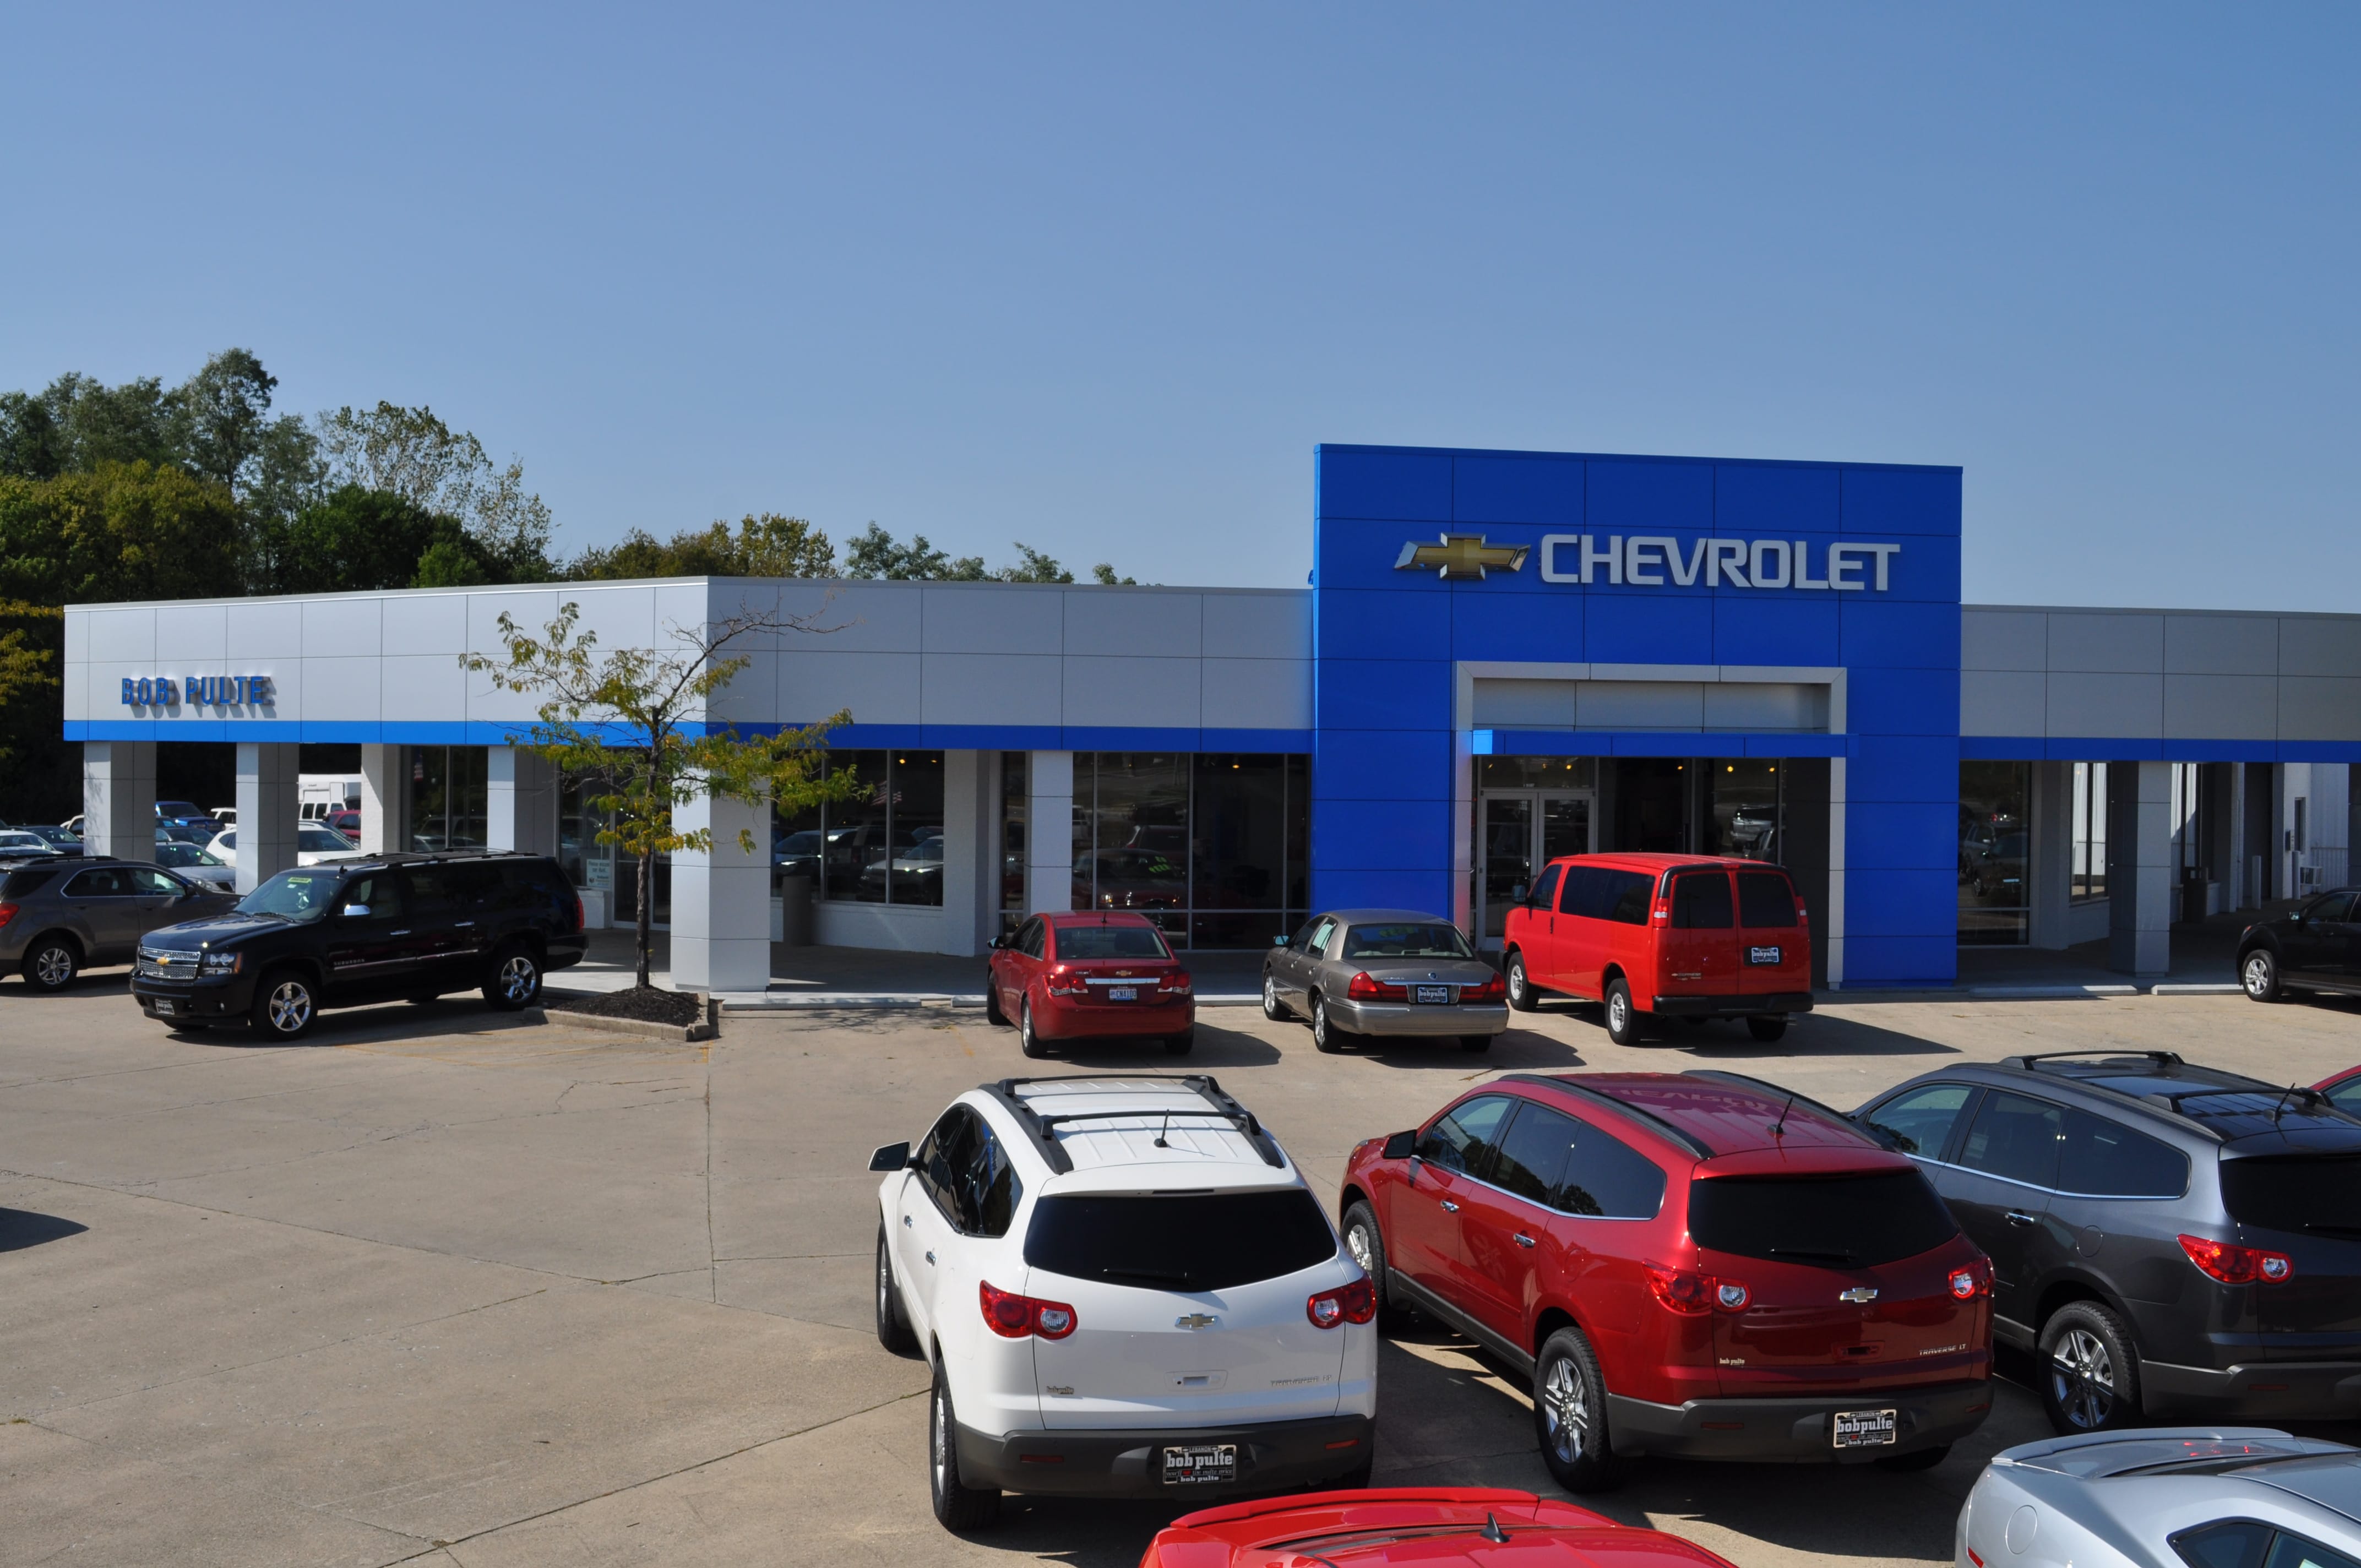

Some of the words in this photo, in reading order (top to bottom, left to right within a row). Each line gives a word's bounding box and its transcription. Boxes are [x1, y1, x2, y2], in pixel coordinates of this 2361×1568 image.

[1541, 533, 1901, 591] CHEVROLET
[122, 677, 170, 706] BOB
[186, 676, 264, 705] PULTE
[1919, 1346, 1956, 1355] TRAVERSE
[1837, 1418, 1860, 1433] bob
[1860, 1417, 1893, 1435] pulte
[1166, 1452, 1194, 1467] bob
[1195, 1451, 1233, 1470] pulte
